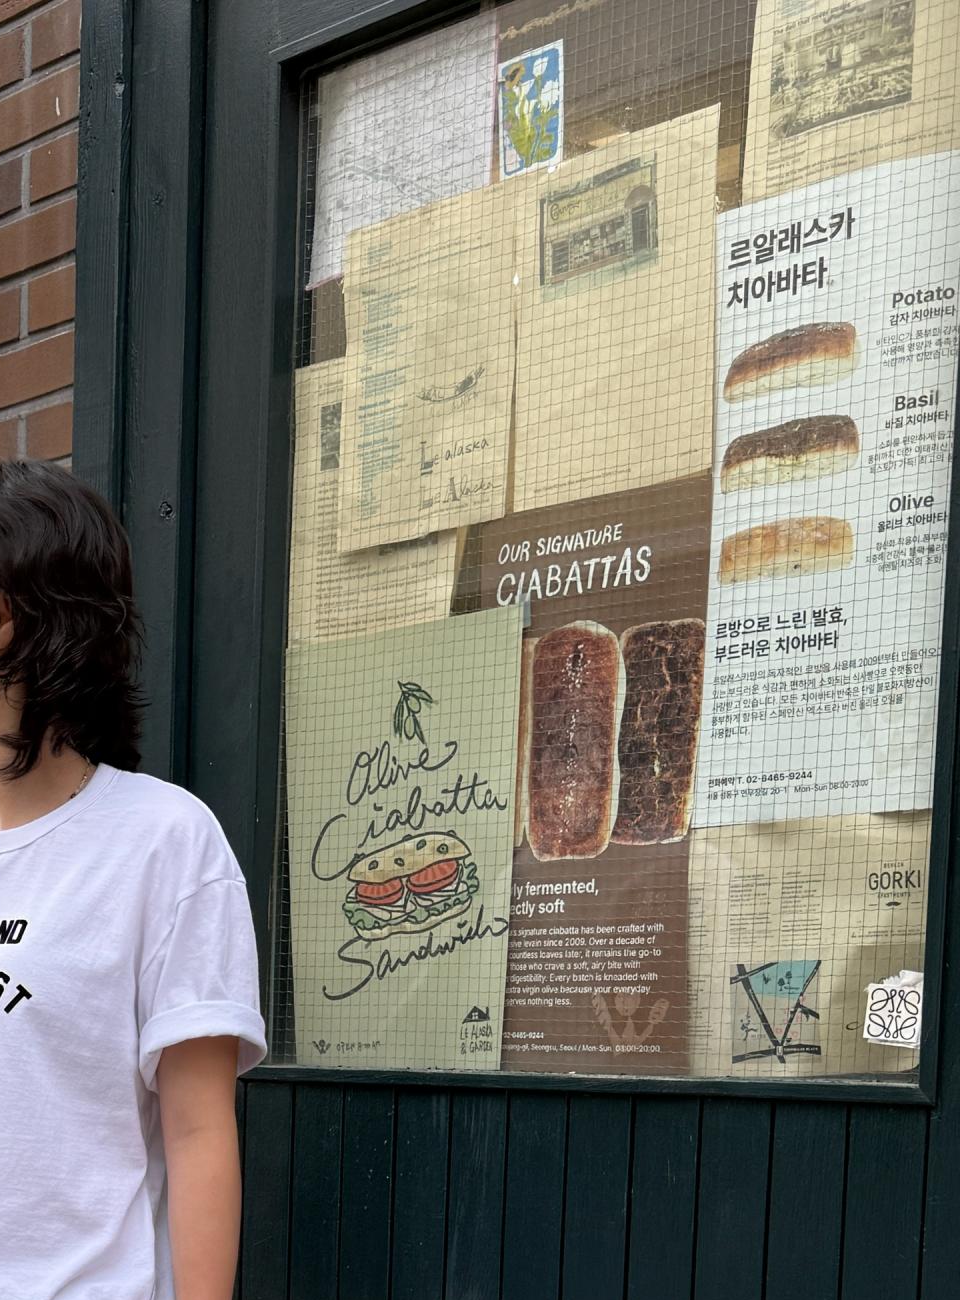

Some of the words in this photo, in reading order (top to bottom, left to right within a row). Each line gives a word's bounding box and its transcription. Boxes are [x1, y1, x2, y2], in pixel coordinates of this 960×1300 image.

[728, 207, 856, 270] 르알래스카
[727, 256, 828, 308] 치아바타
[892, 286, 956, 308] Potato
[889, 312, 910, 326] 감자
[912, 304, 956, 321] 치아바타
[895, 389, 939, 411] Basil
[885, 416, 903, 429] 바질
[906, 409, 949, 425] 치아바타
[889, 494, 934, 513] Olive
[878, 518, 903, 533] 올리브
[906, 510, 947, 527] 치아바타
[498, 541, 531, 565] OUR
[536, 523, 623, 556] SIGNATURE
[496, 545, 652, 607] CIABATTAS
[715, 616, 771, 639] 르방으로
[775, 610, 807, 630] 느린
[812, 606, 848, 627] 발효,
[714, 639, 770, 663] 부드러운
[775, 630, 839, 654] 치아바타
[768, 666, 803, 679] 독자적인
[805, 662, 832, 675] 르방을
[858, 651, 899, 668] 2009년부터
[728, 684, 760, 697] 부드러운
[762, 681, 787, 693] 식감과
[790, 678, 816, 690] 편하게
[780, 694, 799, 704] 모든
[801, 690, 835, 703] 치아바타
[769, 708, 804, 719] 스페인산
[806, 703, 840, 716] 엑스트라
[842, 701, 857, 711] 버진
[346, 740, 458, 806] Olive
[794, 783, 827, 793] Mon-Sun
[312, 772, 508, 882] Ciabatta
[511, 883, 523, 899] ly
[525, 878, 599, 897] fermented,
[869, 869, 921, 890] GORKI
[538, 899, 565, 914] soft
[518, 926, 547, 939] signature
[549, 924, 579, 936] ciabatta
[581, 923, 594, 934] has
[596, 923, 616, 934] been
[617, 921, 645, 933] crafted
[646, 922, 665, 932] with
[543, 938, 563, 947] since
[565, 937, 586, 946] 2009.
[589, 937, 607, 946] Over
[615, 935, 645, 946] decade
[646, 935, 656, 945] of
[323, 904, 509, 1001] Sandwich
[539, 949, 563, 959] loaves
[591, 948, 622, 958] remains
[623, 948, 637, 957] the
[638, 948, 662, 960] go-to
[528, 962, 543, 971] who
[544, 962, 565, 971] crave
[591, 961, 607, 973] airy
[607, 960, 622, 970] bite
[623, 960, 641, 970] with
[549, 973, 571, 984] Every
[572, 973, 594, 982] batch
[595, 973, 602, 981] is
[603, 972, 638, 982] kneaded
[640, 971, 658, 981] with
[541, 984, 558, 994] olive
[559, 984, 592, 994] because
[593, 985, 612, 996] your
[613, 984, 651, 996] everyday
[554, 996, 572, 1006] less.
